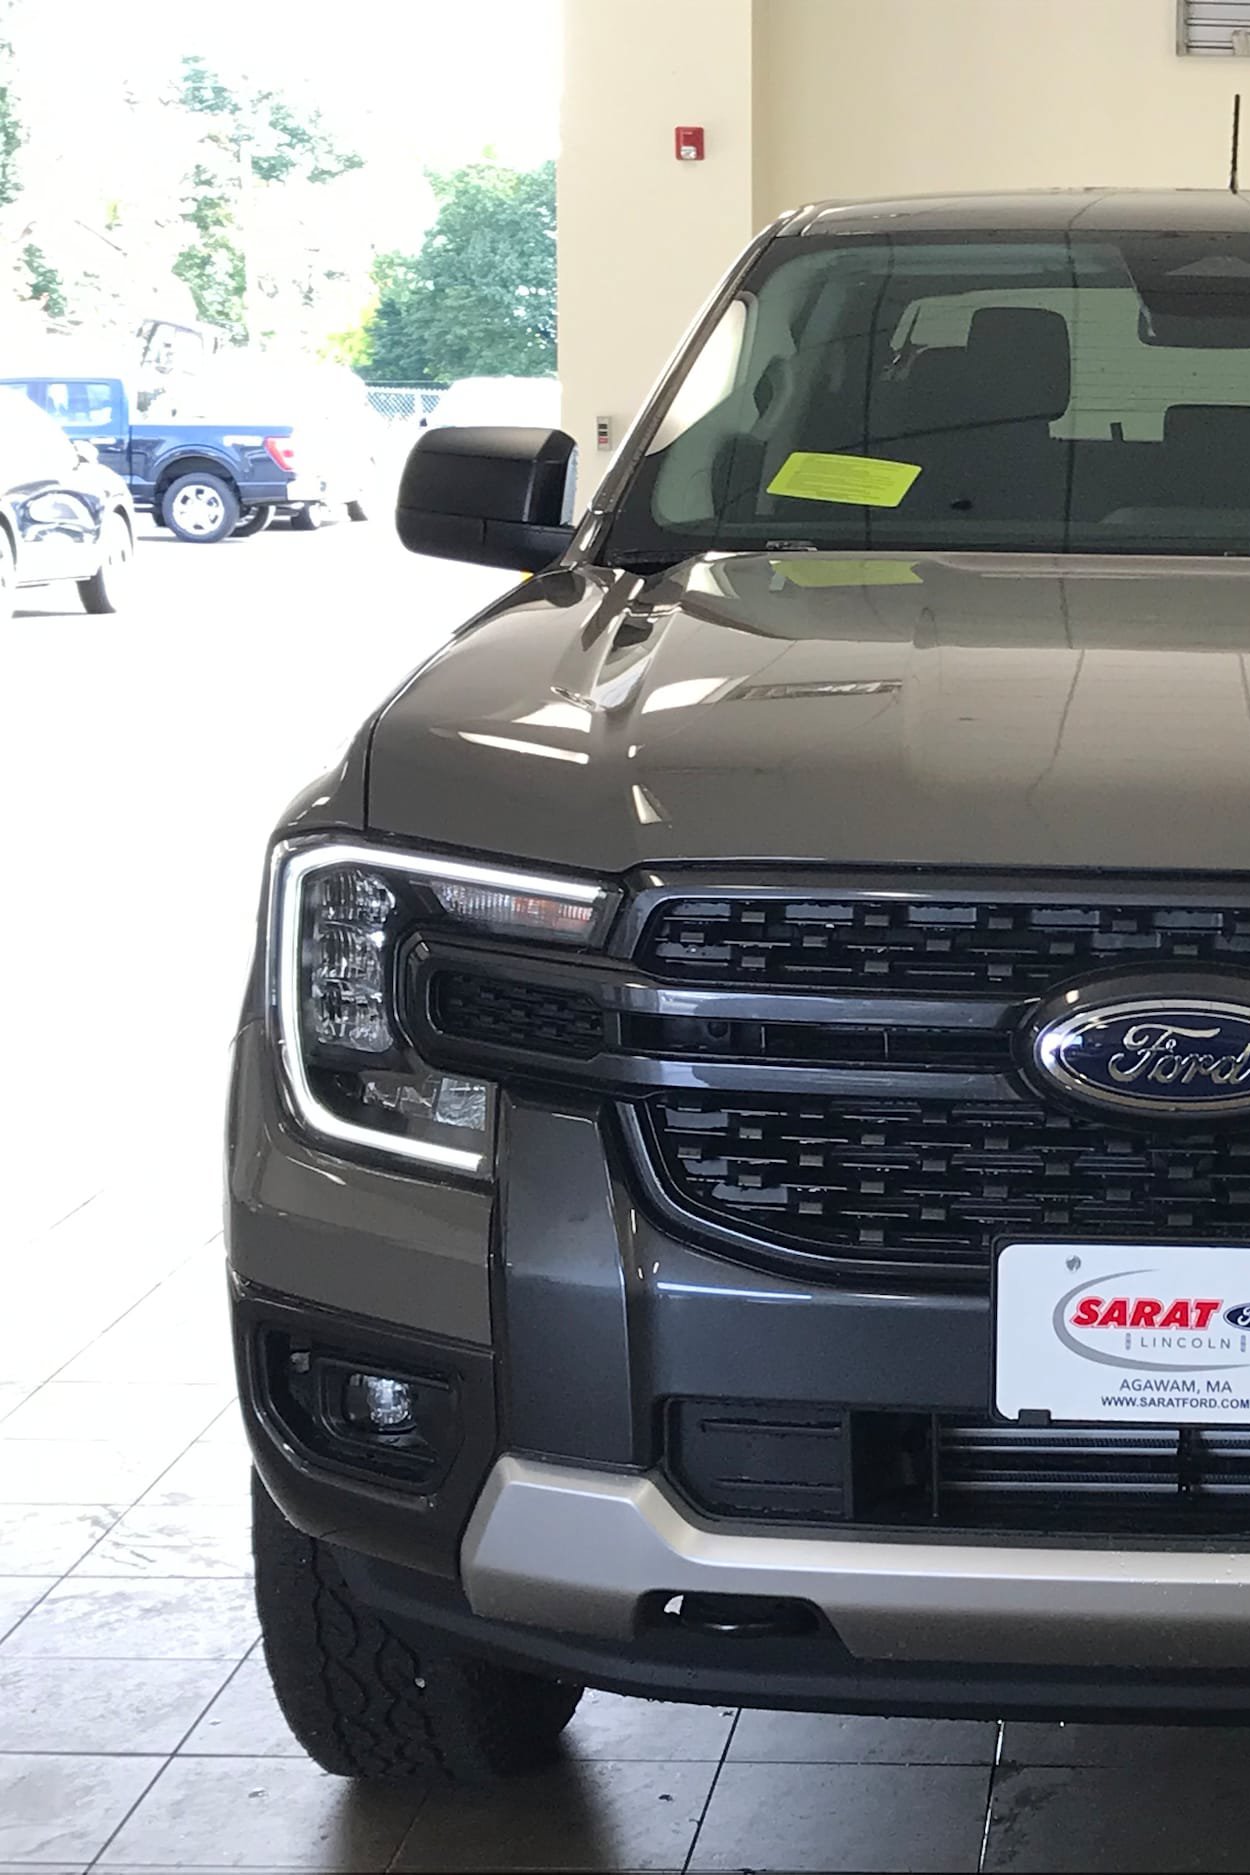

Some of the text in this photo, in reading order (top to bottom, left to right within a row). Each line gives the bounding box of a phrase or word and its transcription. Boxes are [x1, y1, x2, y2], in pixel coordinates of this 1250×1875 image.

[1070, 1297, 1223, 1331] SARAT
[1140, 1336, 1231, 1350] LINCOLN
[1119, 1379, 1232, 1395] AGAWAM, MA
[1101, 1396, 1250, 1410] WWW.SARATFORD.COM
